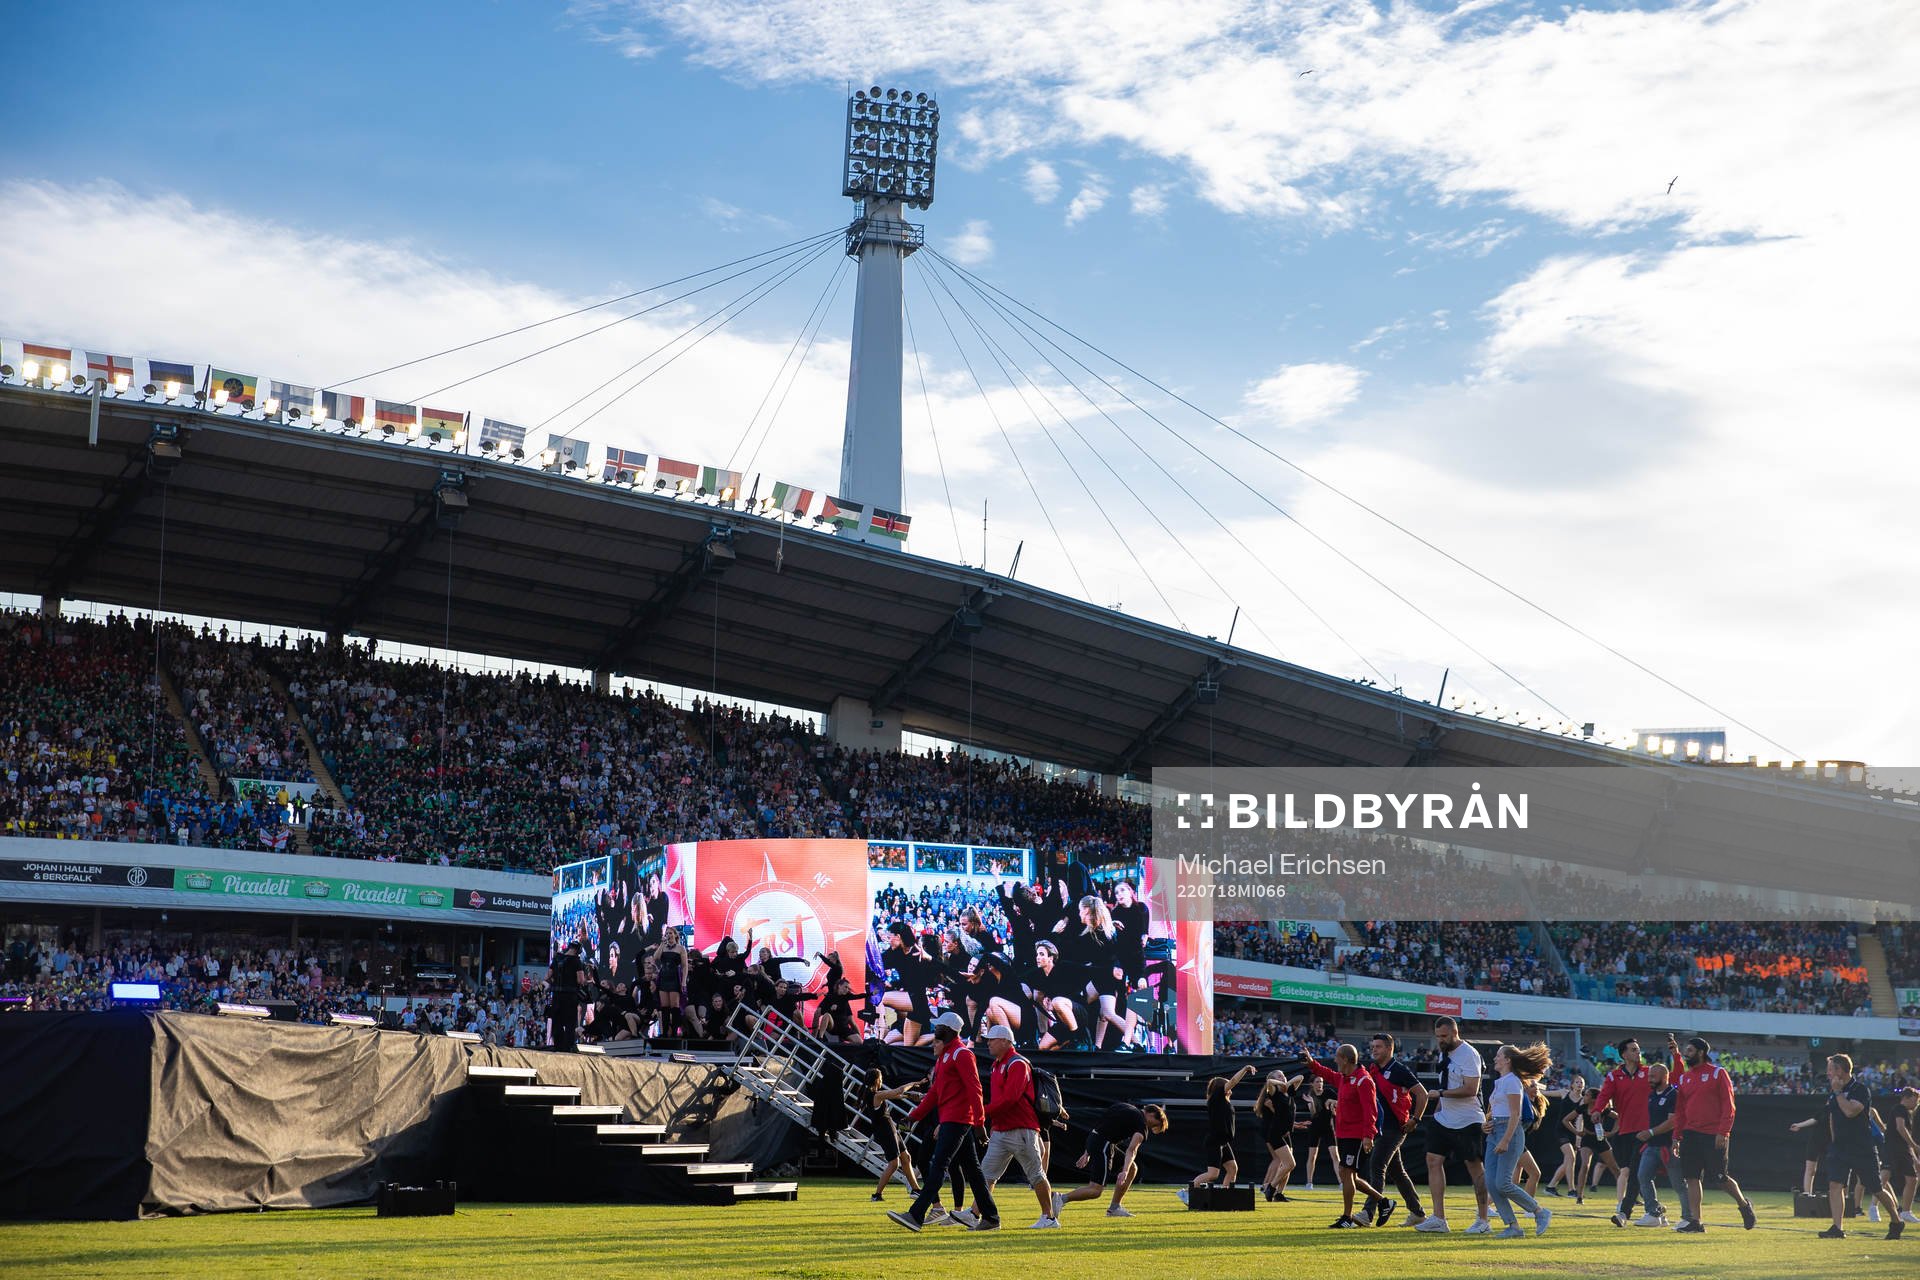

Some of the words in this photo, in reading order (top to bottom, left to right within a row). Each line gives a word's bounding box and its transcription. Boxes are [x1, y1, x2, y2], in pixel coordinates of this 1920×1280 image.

[23, 863, 57, 872] JOHAN
[64, 865, 102, 874] HALLEN
[43, 873, 93, 882] BERGFALK
[223, 874, 288, 896] Picadeli
[342, 882, 408, 904] Picadeli
[492, 896, 520, 909] Lördag
[522, 899, 539, 909] hela
[1238, 983, 1268, 992] nordstan
[1280, 986, 1323, 999] Göteborgs
[1325, 991, 1354, 1001] största
